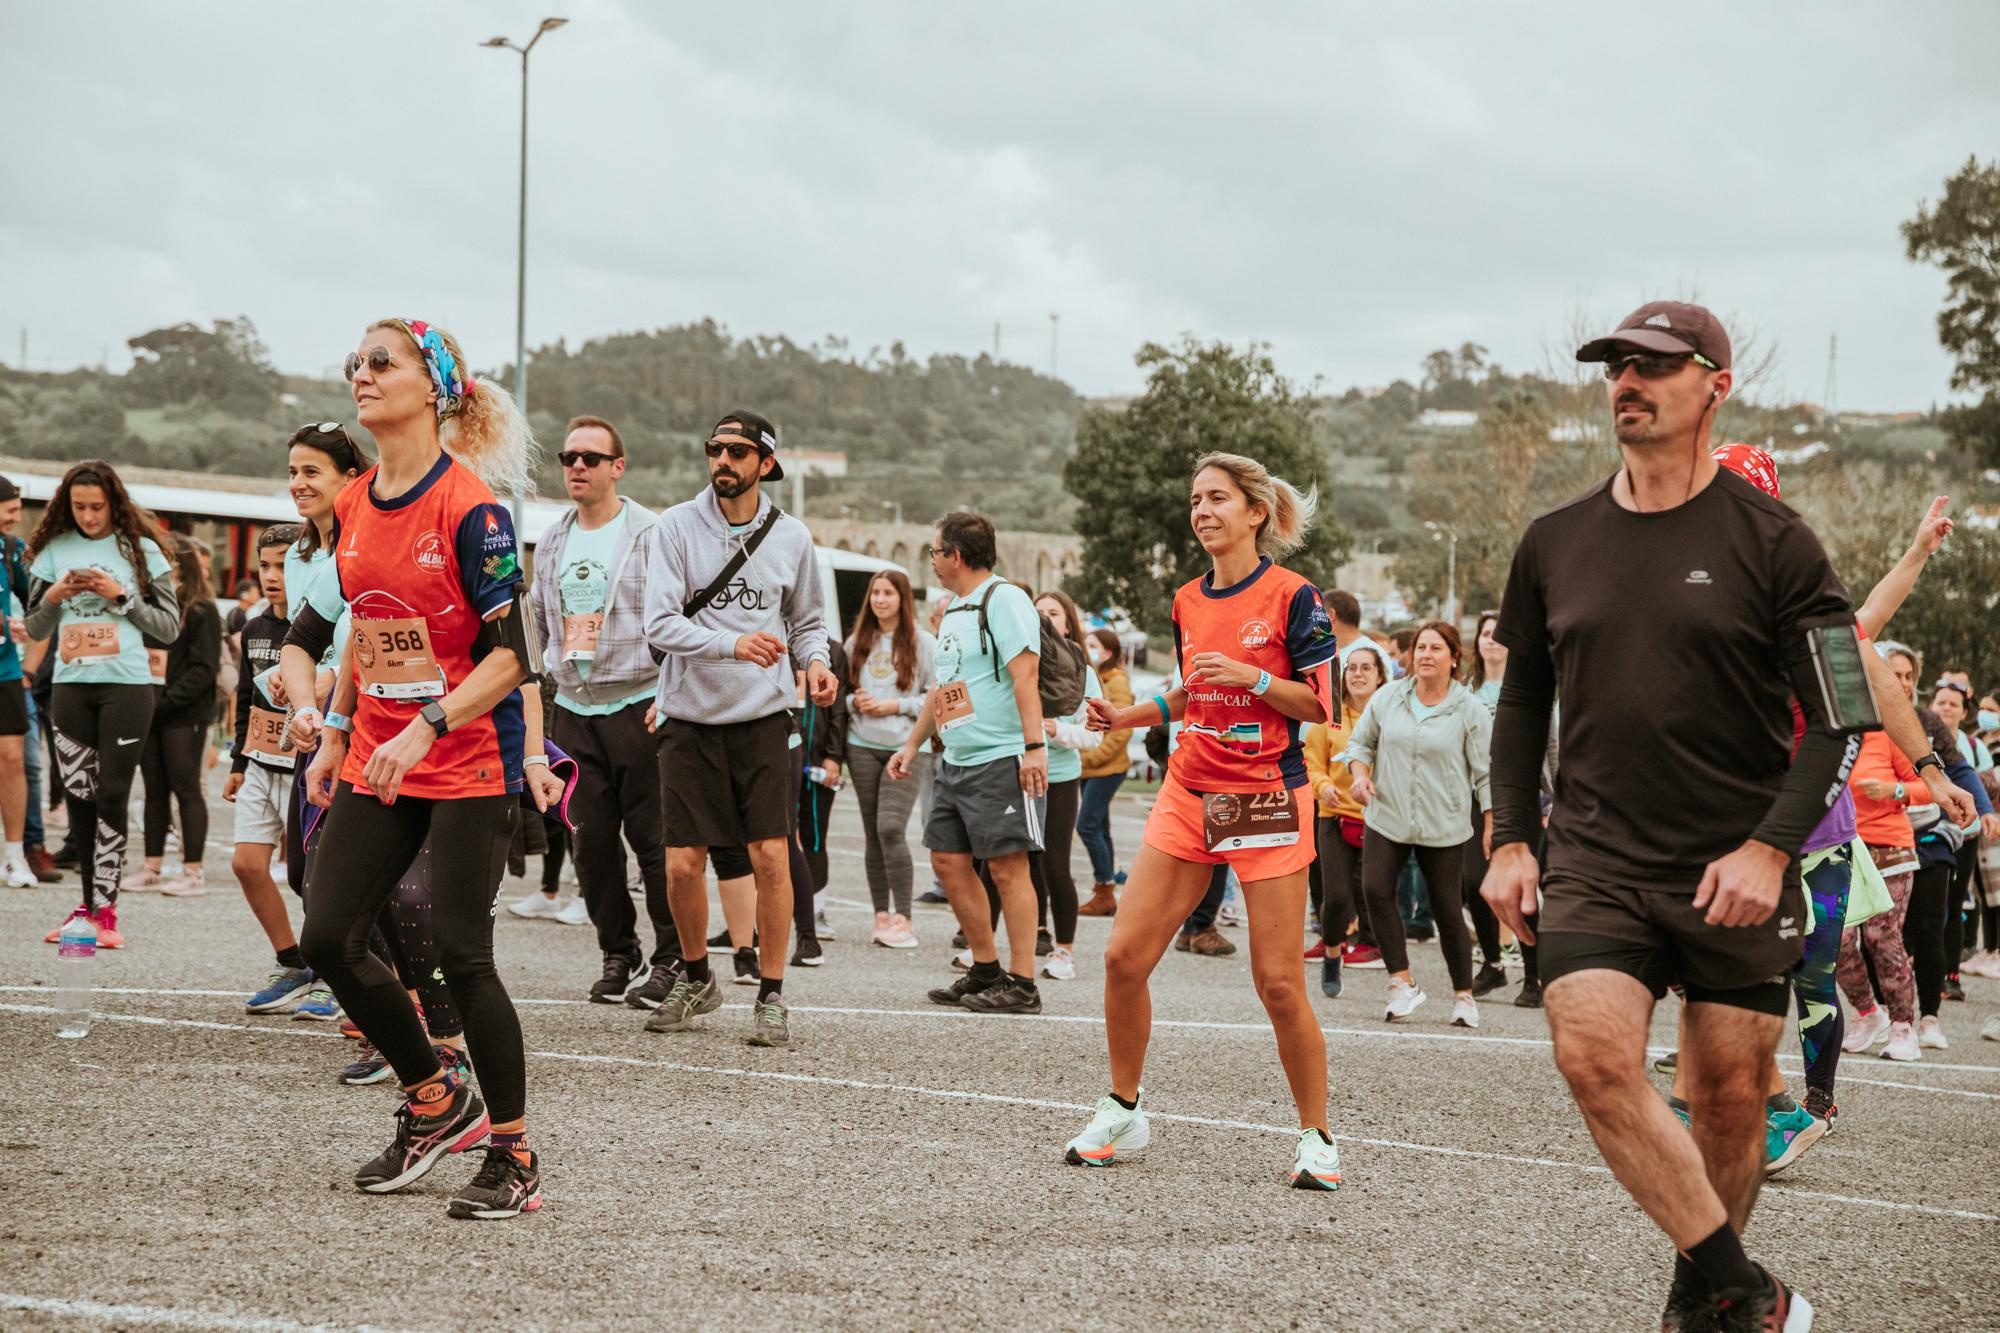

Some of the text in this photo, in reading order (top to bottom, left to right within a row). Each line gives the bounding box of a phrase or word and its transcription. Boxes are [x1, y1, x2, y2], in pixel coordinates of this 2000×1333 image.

[87, 628, 114, 639] 435
[379, 630, 424, 653] 368
[387, 659, 404, 667] 6km
[944, 687, 964, 704] 331
[267, 720, 284, 734] 38
[1249, 790, 1289, 809] 229
[1251, 813, 1270, 821] 10km
